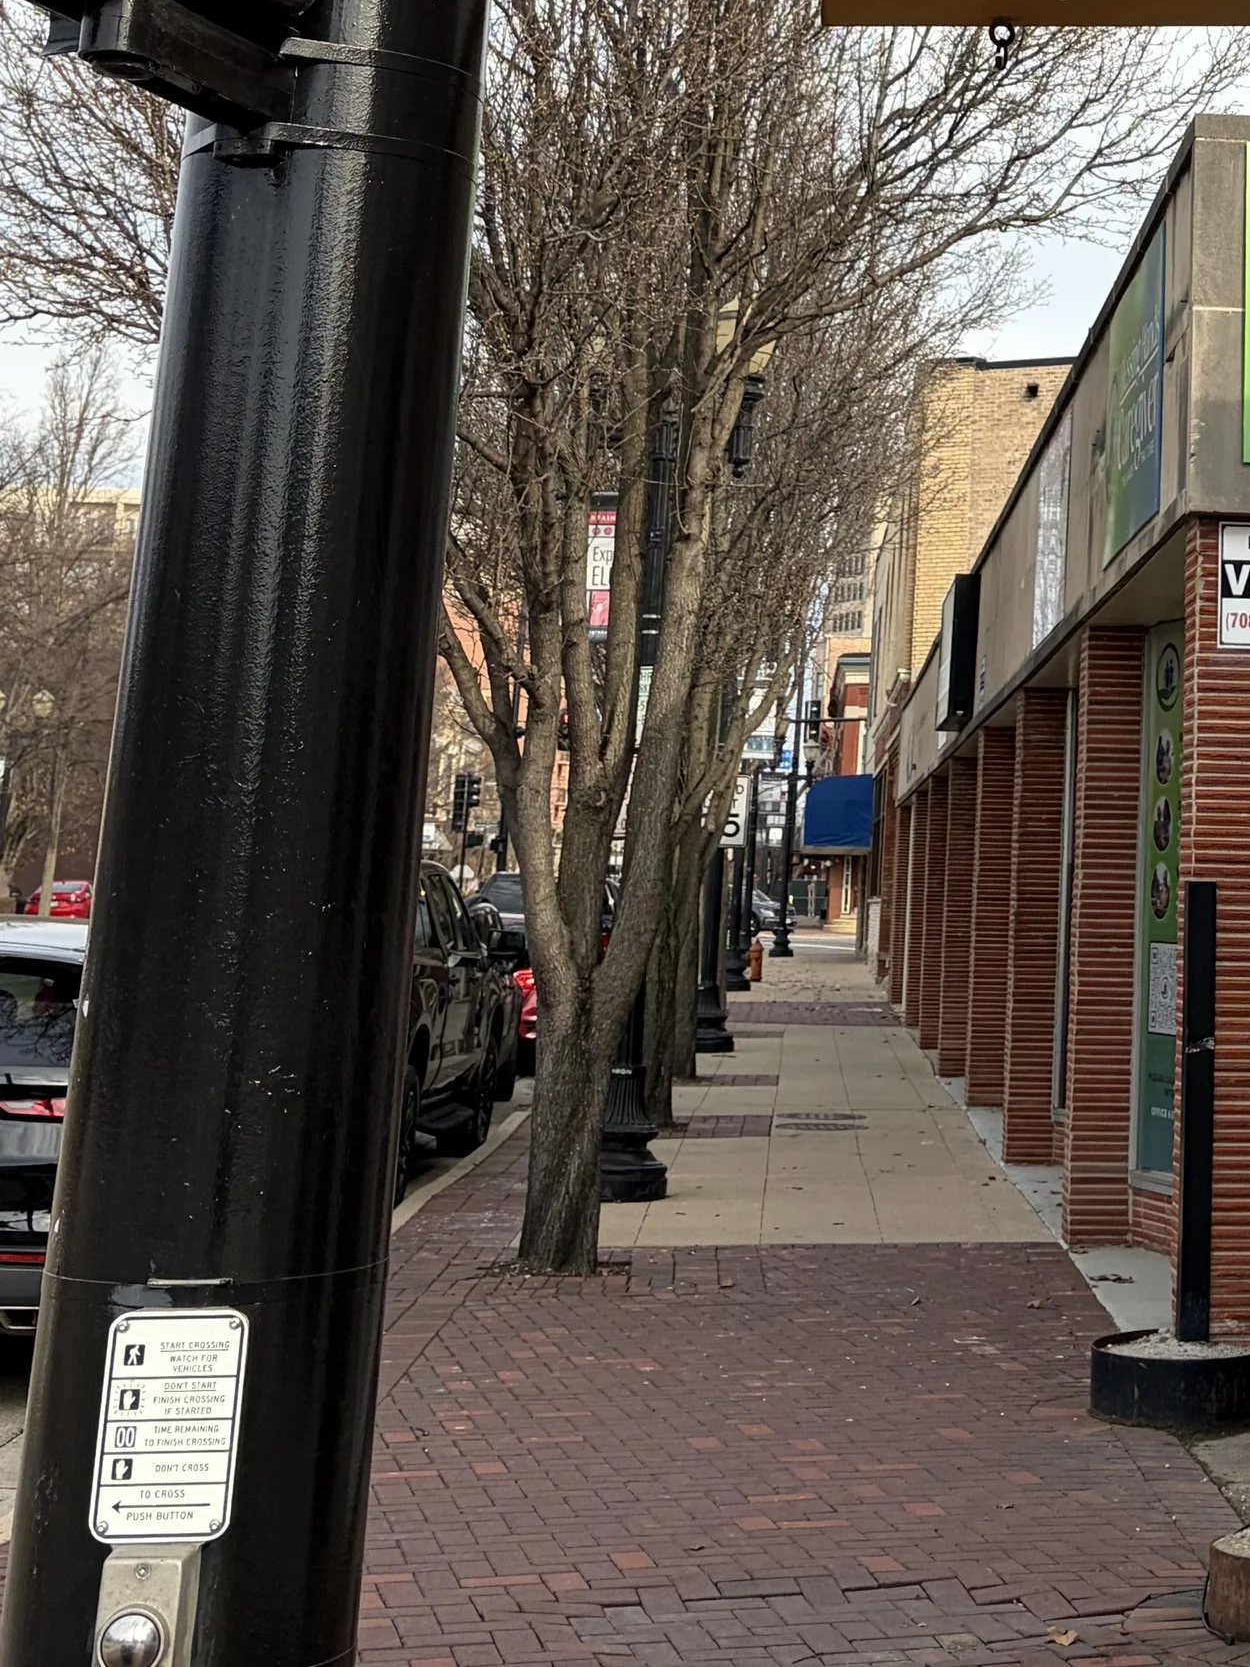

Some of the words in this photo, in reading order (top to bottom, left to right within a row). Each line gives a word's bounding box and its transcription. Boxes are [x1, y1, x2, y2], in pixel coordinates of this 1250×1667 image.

[592, 546, 613, 566] Exp
[723, 813, 740, 838] 5
[160, 1342, 185, 1350] START
[188, 1341, 230, 1349] CROSSING
[170, 1355, 198, 1363] WATCH
[201, 1354, 218, 1362] FOR
[173, 1364, 213, 1372] VEHICLES
[164, 1382, 188, 1390] DON'T
[192, 1381, 216, 1389] START
[153, 1396, 180, 1404] FINISH
[183, 1395, 225, 1403] CROSSING
[175, 1407, 212, 1415] STARTED
[154, 1426, 172, 1434] TIME
[175, 1425, 219, 1433] REMAINING
[144, 1439, 154, 1447] TO
[156, 1438, 183, 1446] FINISH
[186, 1437, 226, 1446] CROSSING
[155, 1464, 179, 1472] DON'T
[182, 1463, 209, 1472] CROSS
[140, 1490, 151, 1499] TO
[154, 1489, 185, 1499] CROSS
[126, 1512, 152, 1521] PUSH
[156, 1511, 194, 1521] BUTTON
